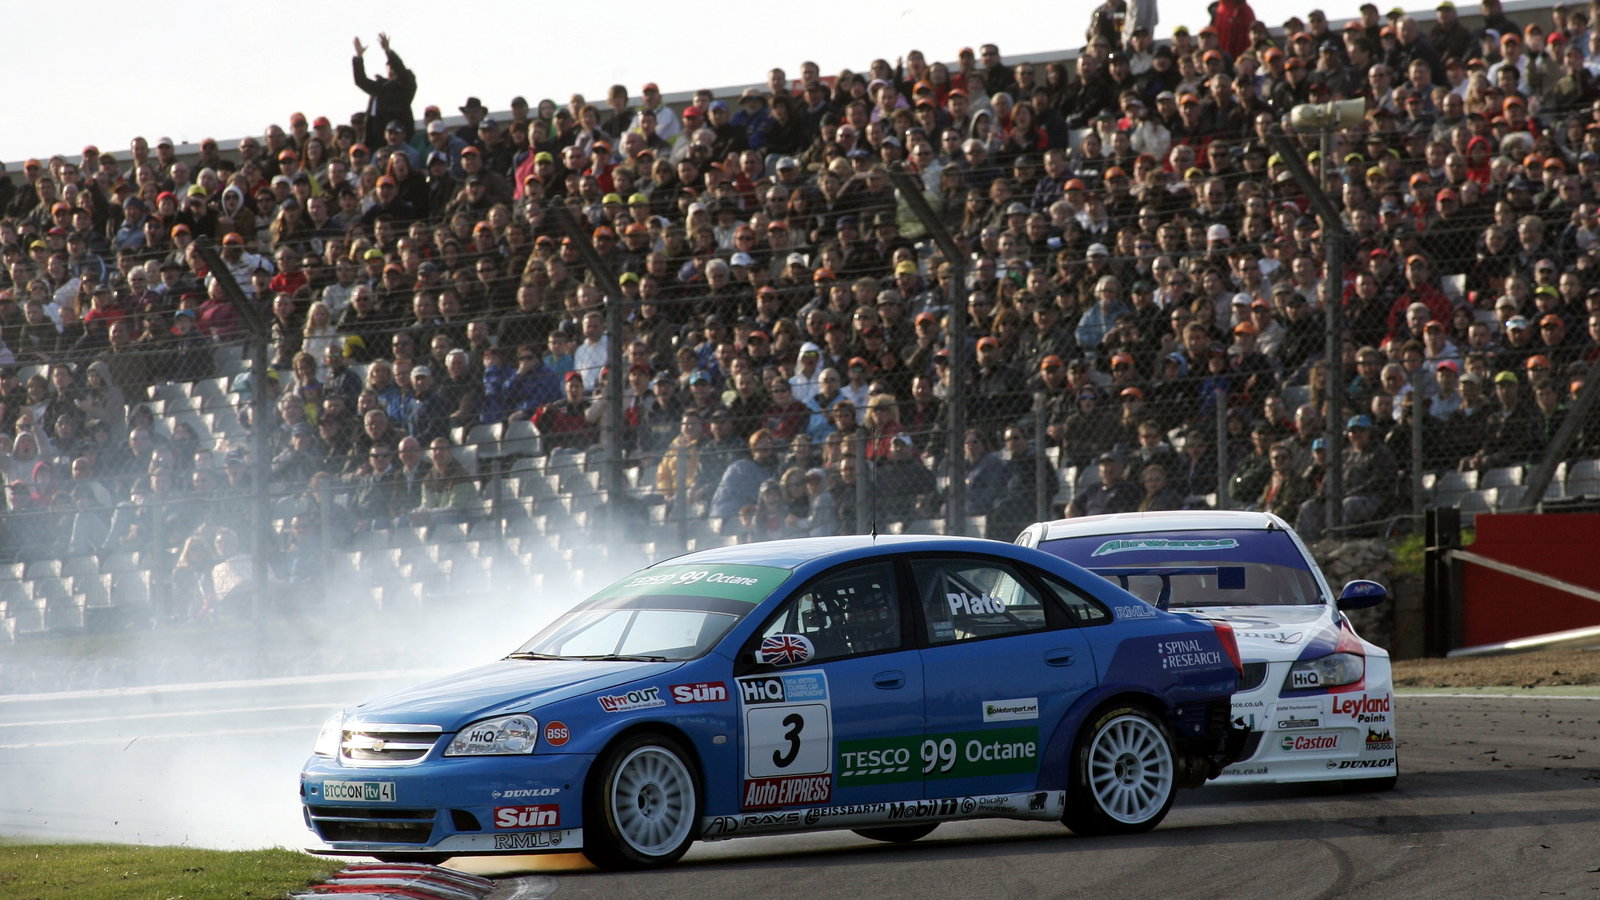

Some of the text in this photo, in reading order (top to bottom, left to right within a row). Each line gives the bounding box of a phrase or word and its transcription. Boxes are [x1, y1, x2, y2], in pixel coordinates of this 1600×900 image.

[672, 571, 709, 585] 99
[706, 572, 758, 586] Octane
[946, 593, 1006, 616] Plato
[1116, 605, 1150, 619] RML
[1165, 640, 1203, 654] SPINAL
[1168, 651, 1221, 668] RESEARCH
[1294, 672, 1319, 686] HiQ
[673, 685, 726, 703] Sun
[741, 679, 784, 701] HiQ
[1231, 701, 1264, 709] nce.co.uk
[1332, 693, 1390, 719] Leyland
[1357, 713, 1386, 724] Paints
[470, 730, 496, 744] HiQ
[547, 728, 568, 740] BSS
[773, 713, 804, 768] 3
[1295, 735, 1338, 750] Castrol
[841, 738, 1036, 774] TESCO 99 Octane
[1339, 757, 1395, 770] DUNLOP
[1223, 766, 1269, 776] ints.co.uk
[365, 784, 379, 798] itv
[382, 784, 389, 799] 4
[503, 788, 560, 798] DUNLOP
[745, 777, 831, 806] Auto EXPRESS
[979, 796, 1009, 806] Chicago
[813, 802, 886, 818] BEISSBARTH
[888, 801, 938, 820] Mobil
[978, 804, 1018, 814] Pneumatic
[495, 808, 558, 828] Sun
[744, 812, 801, 826] RAYS
[494, 833, 550, 850] RML
